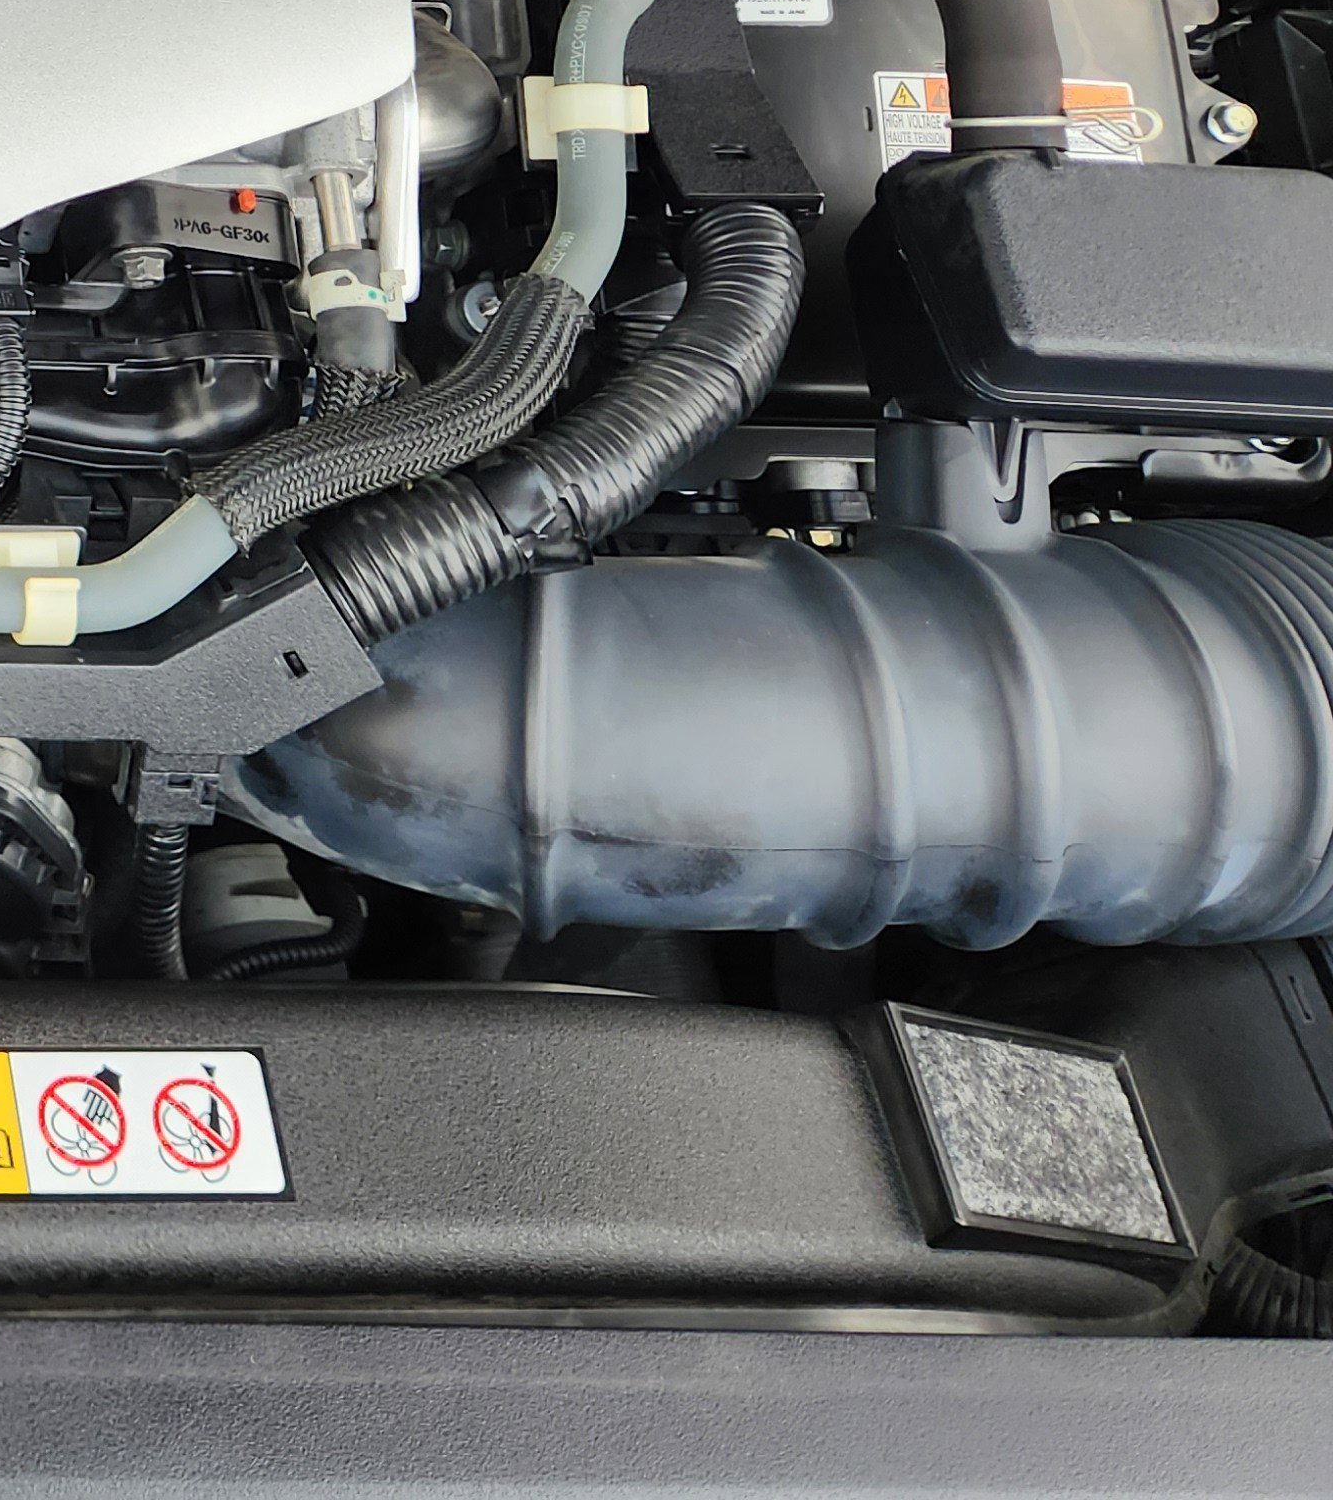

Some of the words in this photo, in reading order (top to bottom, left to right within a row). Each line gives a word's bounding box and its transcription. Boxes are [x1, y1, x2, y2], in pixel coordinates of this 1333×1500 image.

[885, 113, 904, 129] HIGH
[907, 113, 942, 129] VOLTAGE
[887, 131, 912, 144] HAUTE
[913, 131, 947, 145] TENSION
